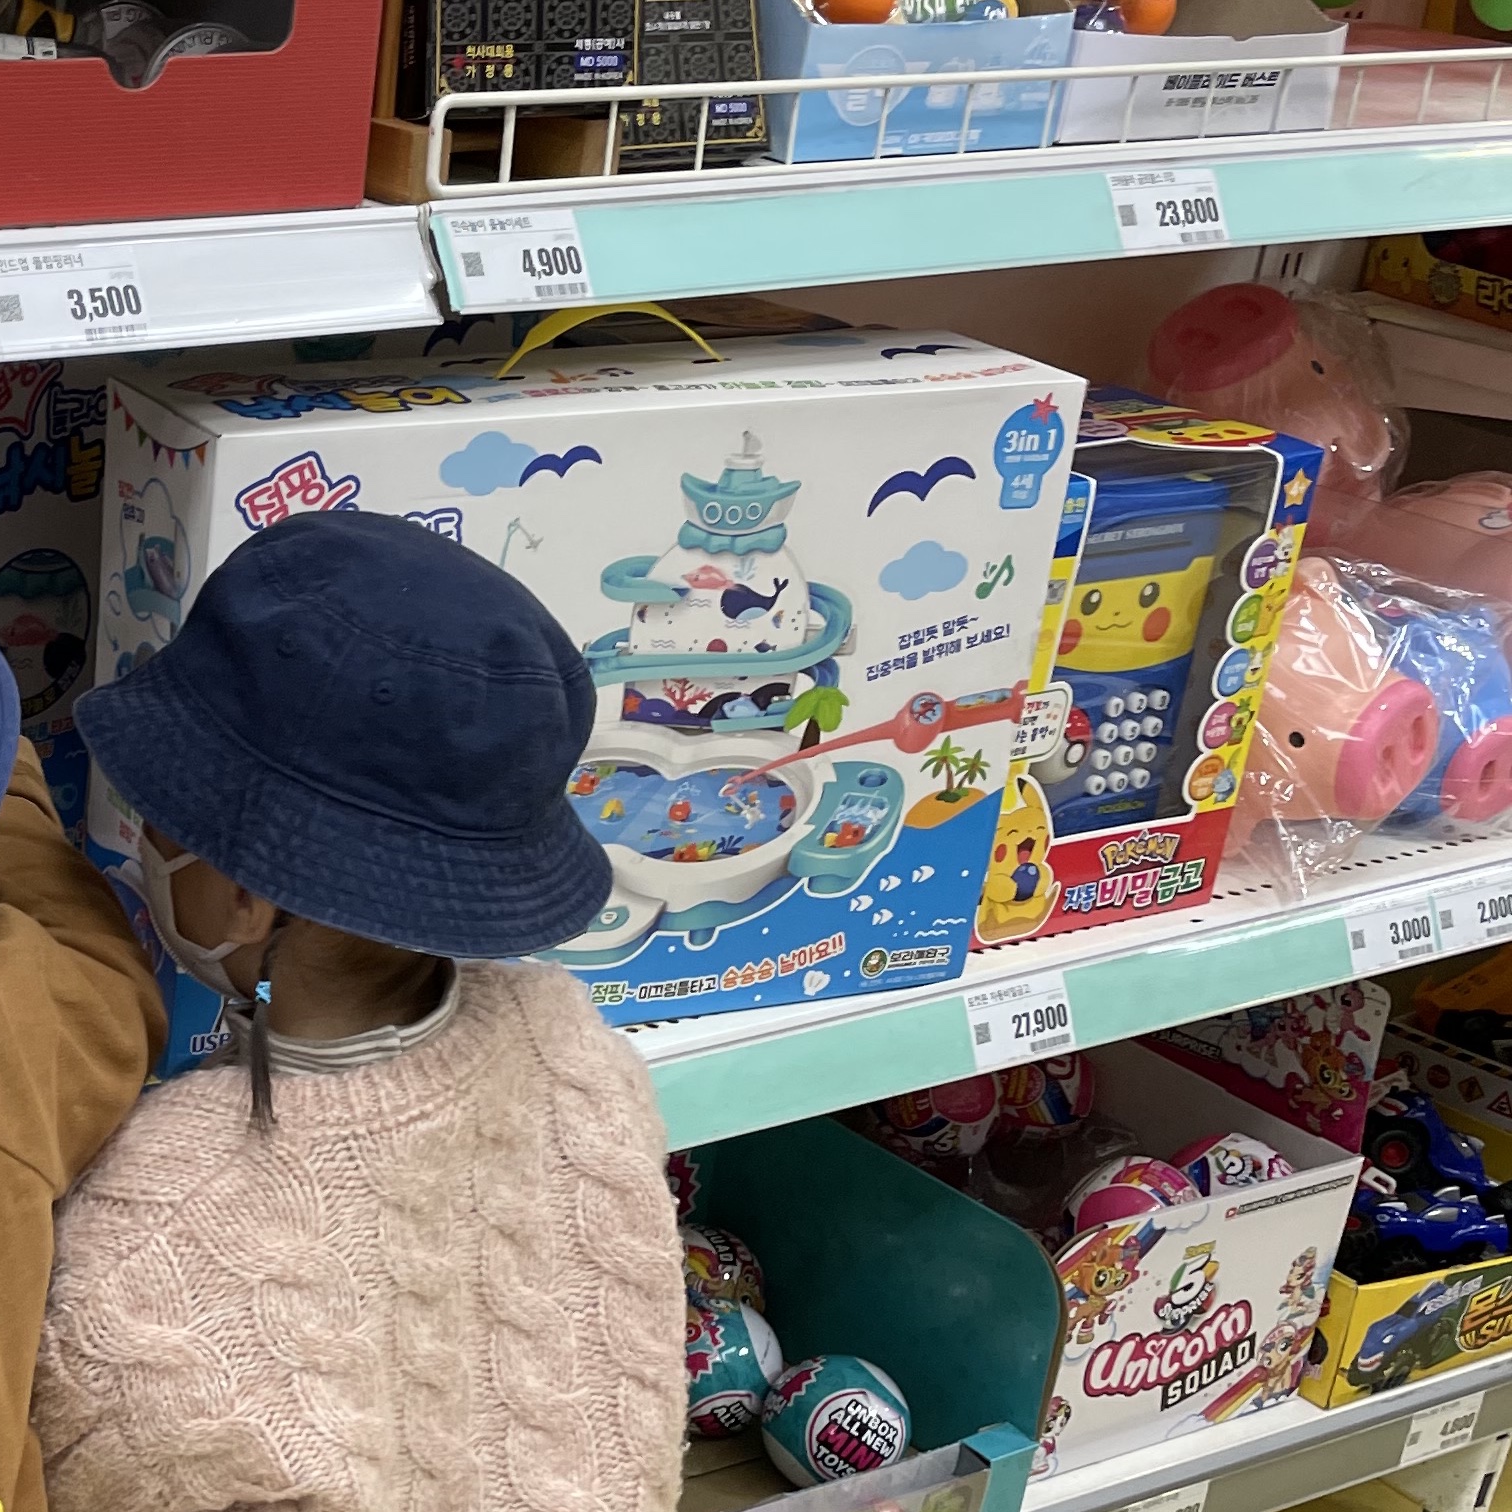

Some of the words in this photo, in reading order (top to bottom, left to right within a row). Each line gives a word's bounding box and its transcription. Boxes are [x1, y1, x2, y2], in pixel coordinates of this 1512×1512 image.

[579, 56, 594, 67] MD
[1155, 197, 1220, 227] 23,800
[522, 245, 583, 280] 4,900
[67, 284, 143, 323] 3,500
[1002, 429, 1041, 453] 3in
[1047, 428, 1058, 451] 1
[966, 623, 1012, 650] 보세요!
[1389, 916, 1431, 945] 3,000
[722, 960, 776, 988] 슝슝슝
[1011, 1003, 1068, 1039] 27,900
[1167, 1339, 1251, 1406] SQUAD
[830, 1408, 860, 1438] ALL
[861, 1428, 894, 1458] NEW
[847, 1400, 898, 1444] UNBOX
